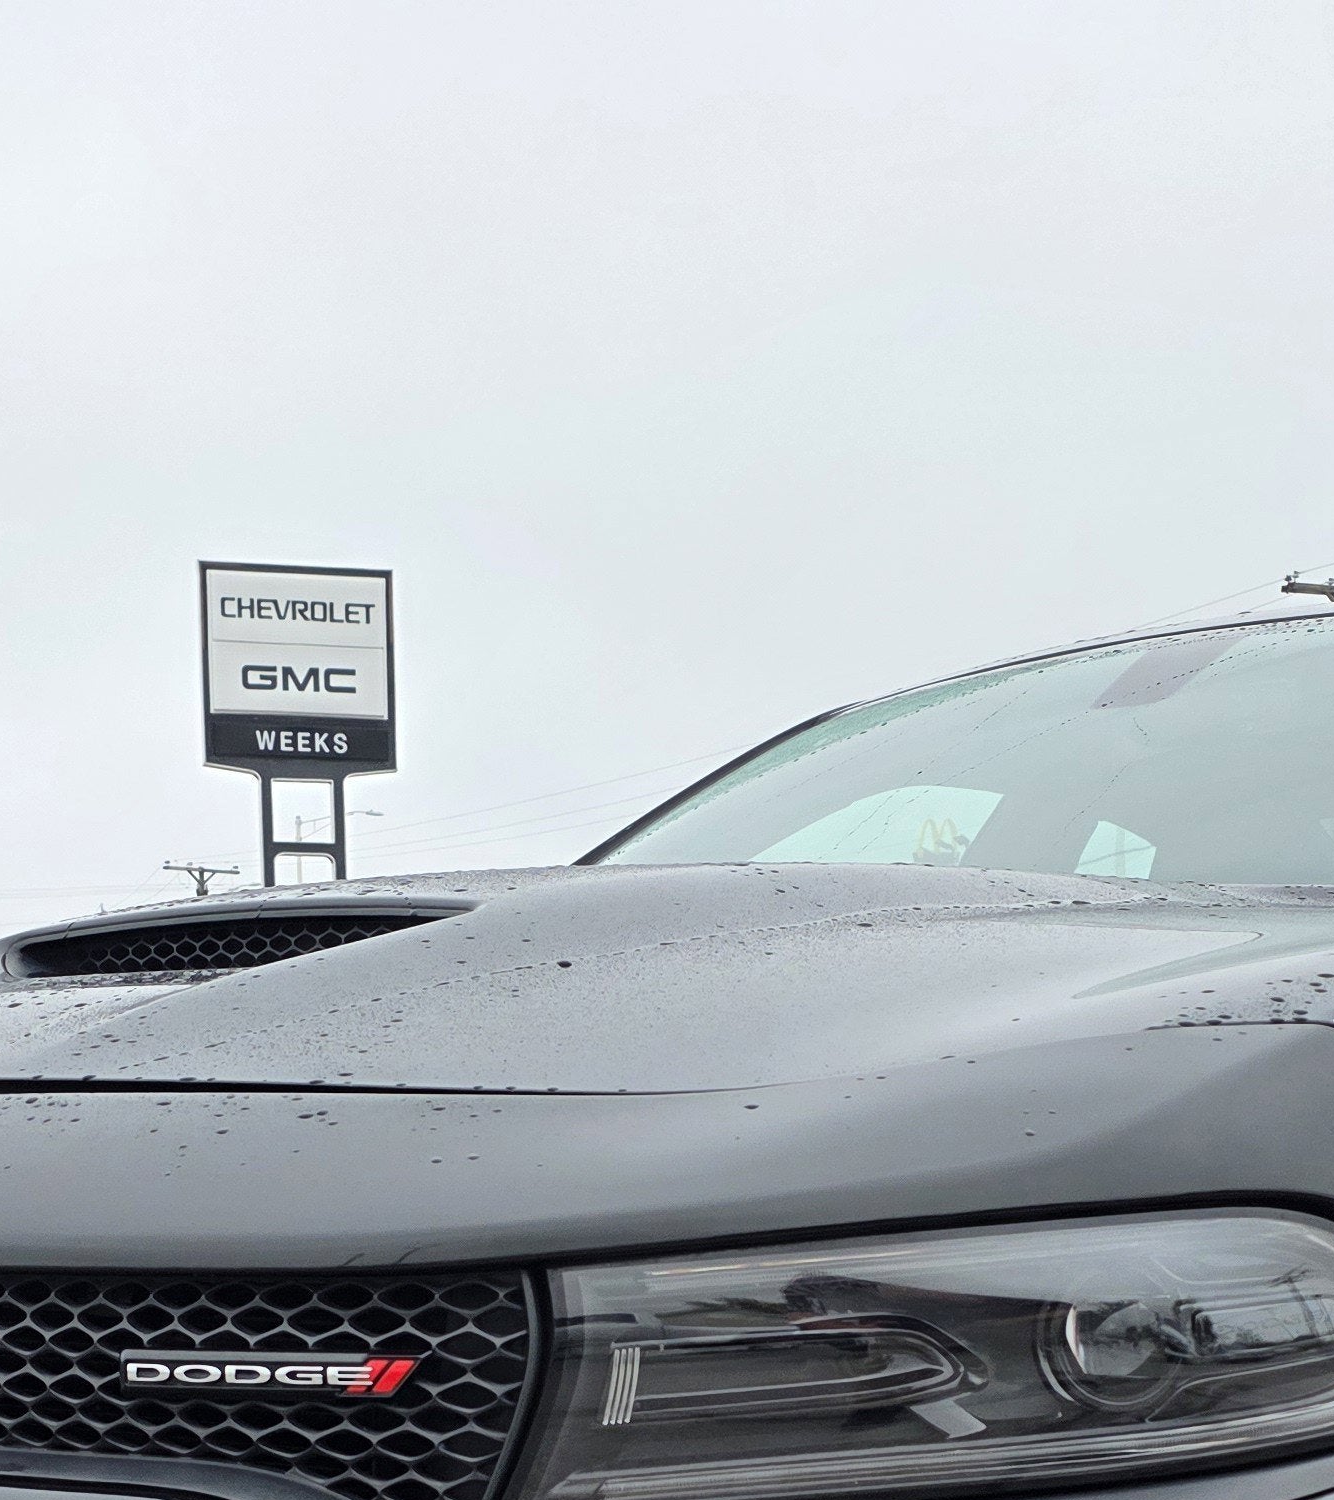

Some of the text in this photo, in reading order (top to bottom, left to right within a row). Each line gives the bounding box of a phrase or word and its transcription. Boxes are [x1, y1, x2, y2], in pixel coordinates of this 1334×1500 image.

[220, 596, 376, 625] CHEVROLET
[241, 664, 357, 694] GMC
[255, 729, 349, 755] WEEKS
[125, 1362, 374, 1386] DODGE
